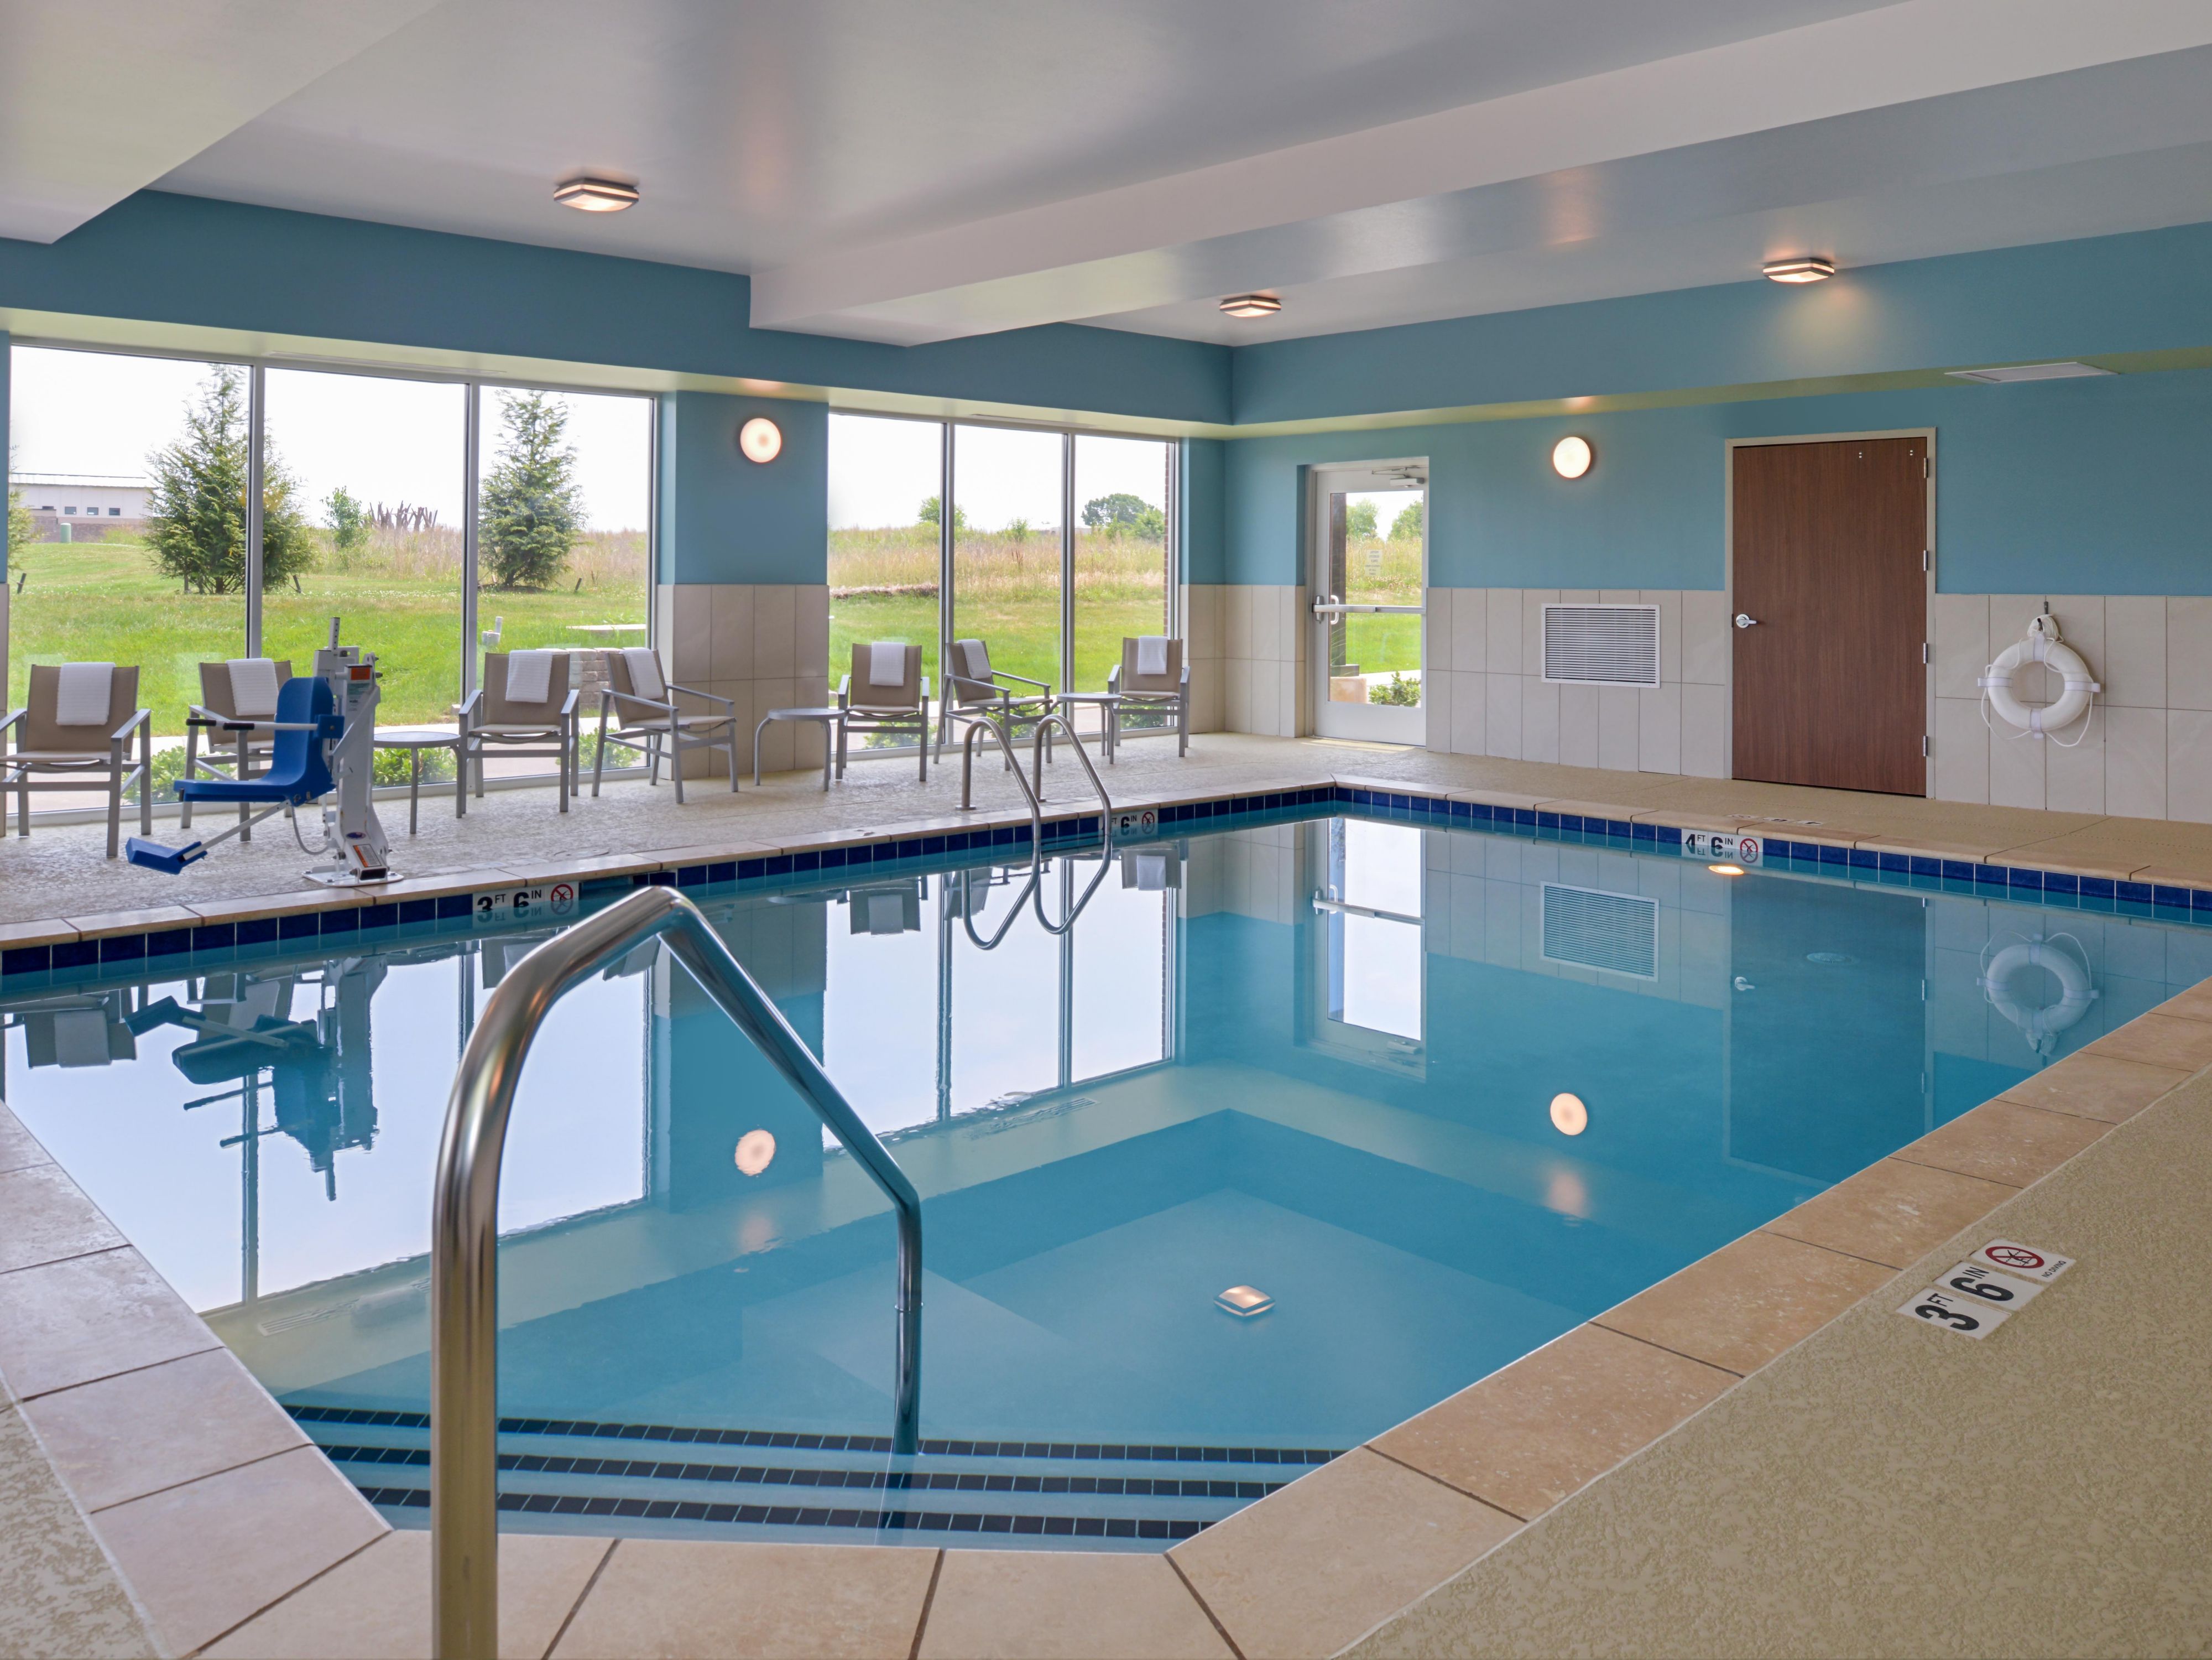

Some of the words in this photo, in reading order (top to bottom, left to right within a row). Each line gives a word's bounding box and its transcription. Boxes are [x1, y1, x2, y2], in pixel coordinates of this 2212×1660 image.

[1711, 836, 1723, 849] 6
[1725, 837, 1733, 846] IN
[495, 894, 506, 904] FT
[514, 892, 529, 908] 6
[531, 889, 542, 899] IN
[1962, 1266, 1989, 1279] IN
[2048, 1260, 2066, 1272] DIVING
[1950, 1277, 2014, 1302] 6
[1927, 1293, 1953, 1307] FT
[1915, 1304, 1979, 1331] 3
